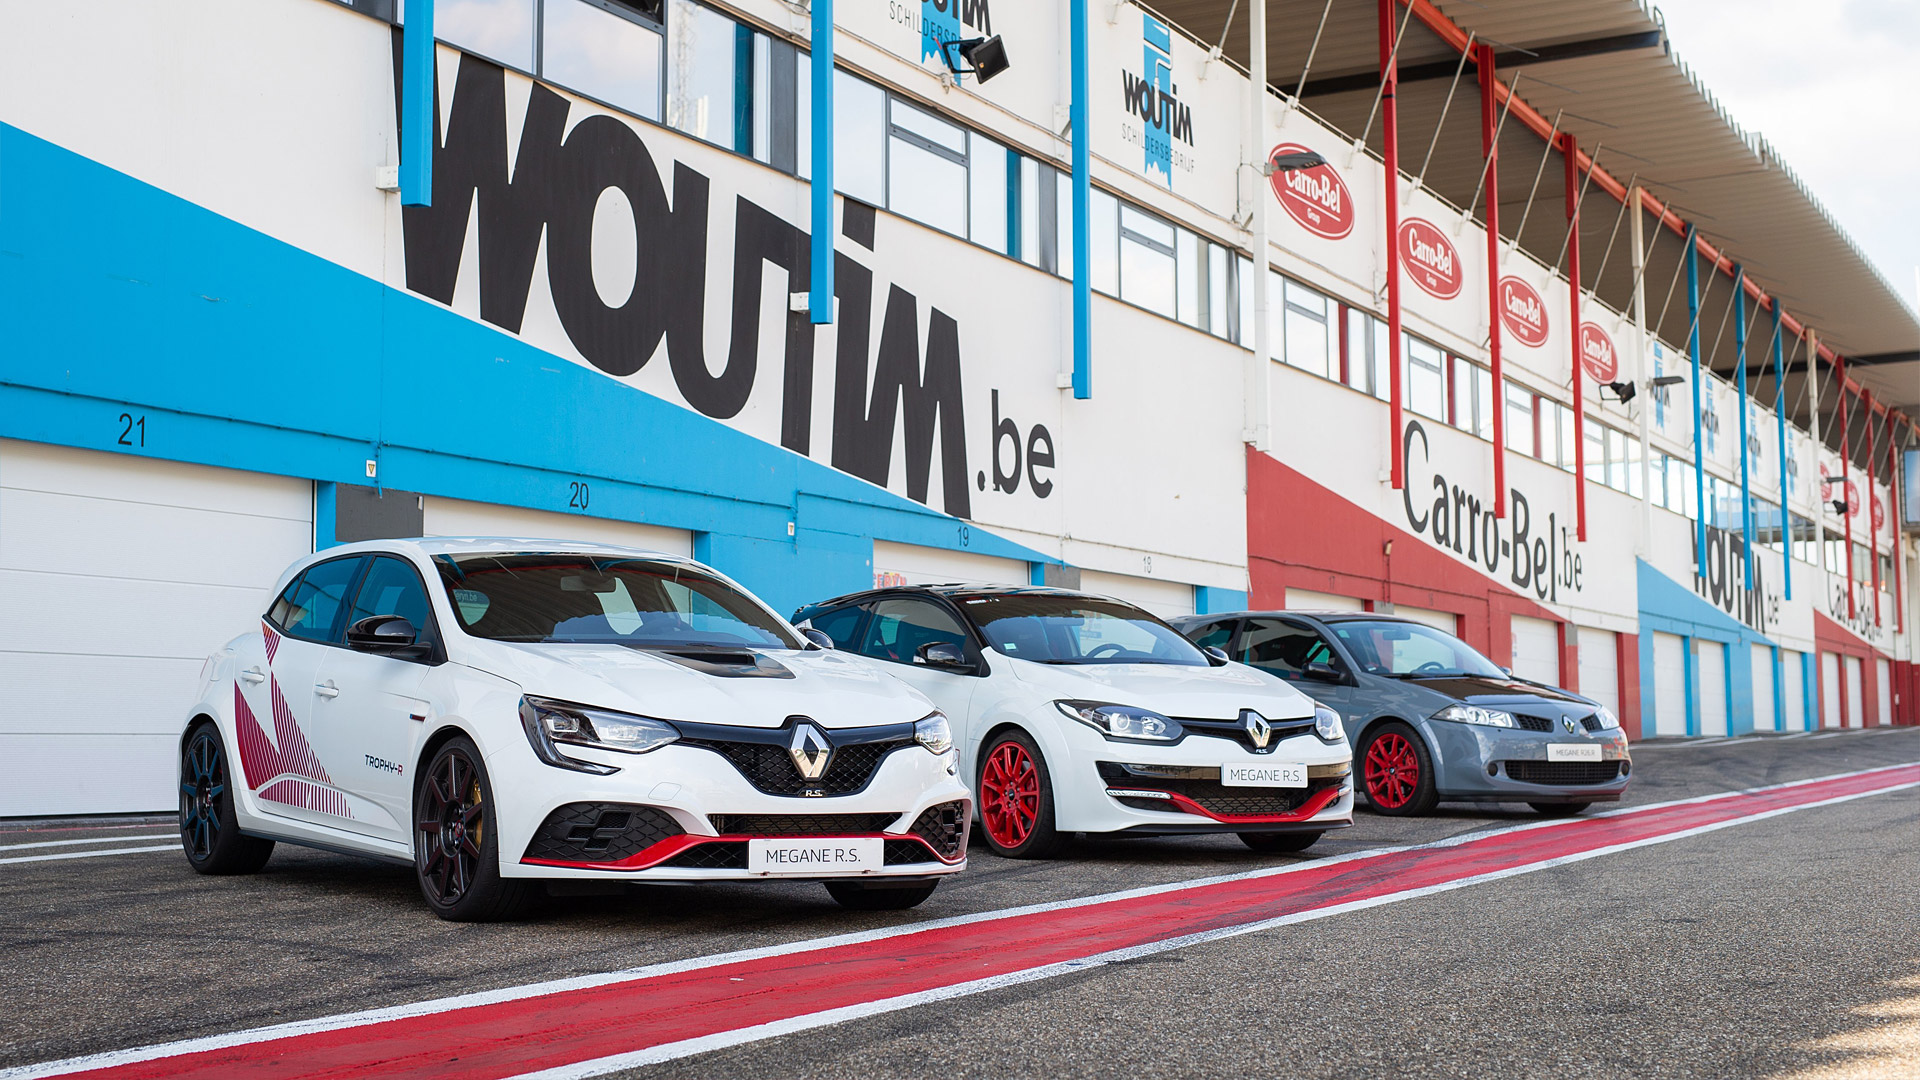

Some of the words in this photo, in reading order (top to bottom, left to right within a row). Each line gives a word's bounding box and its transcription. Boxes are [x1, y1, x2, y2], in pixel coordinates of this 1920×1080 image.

[1122, 123, 1194, 174] SCHILDERSBEDRIJF
[1409, 228, 1453, 276] Carro-Bel
[1505, 285, 1541, 327] Carro-Bel
[118, 413, 145, 447] 21
[569, 481, 589, 510] 20
[957, 526, 970, 547] 19
[1143, 555, 1152, 574] 18
[365, 754, 403, 777] TROPHY-R
[1230, 768, 1280, 782] MEGANE
[1283, 769, 1302, 782] R.S.
[805, 789, 823, 797] R.S.
[766, 848, 831, 864] MEGANE
[835, 848, 861, 863] R.S.
